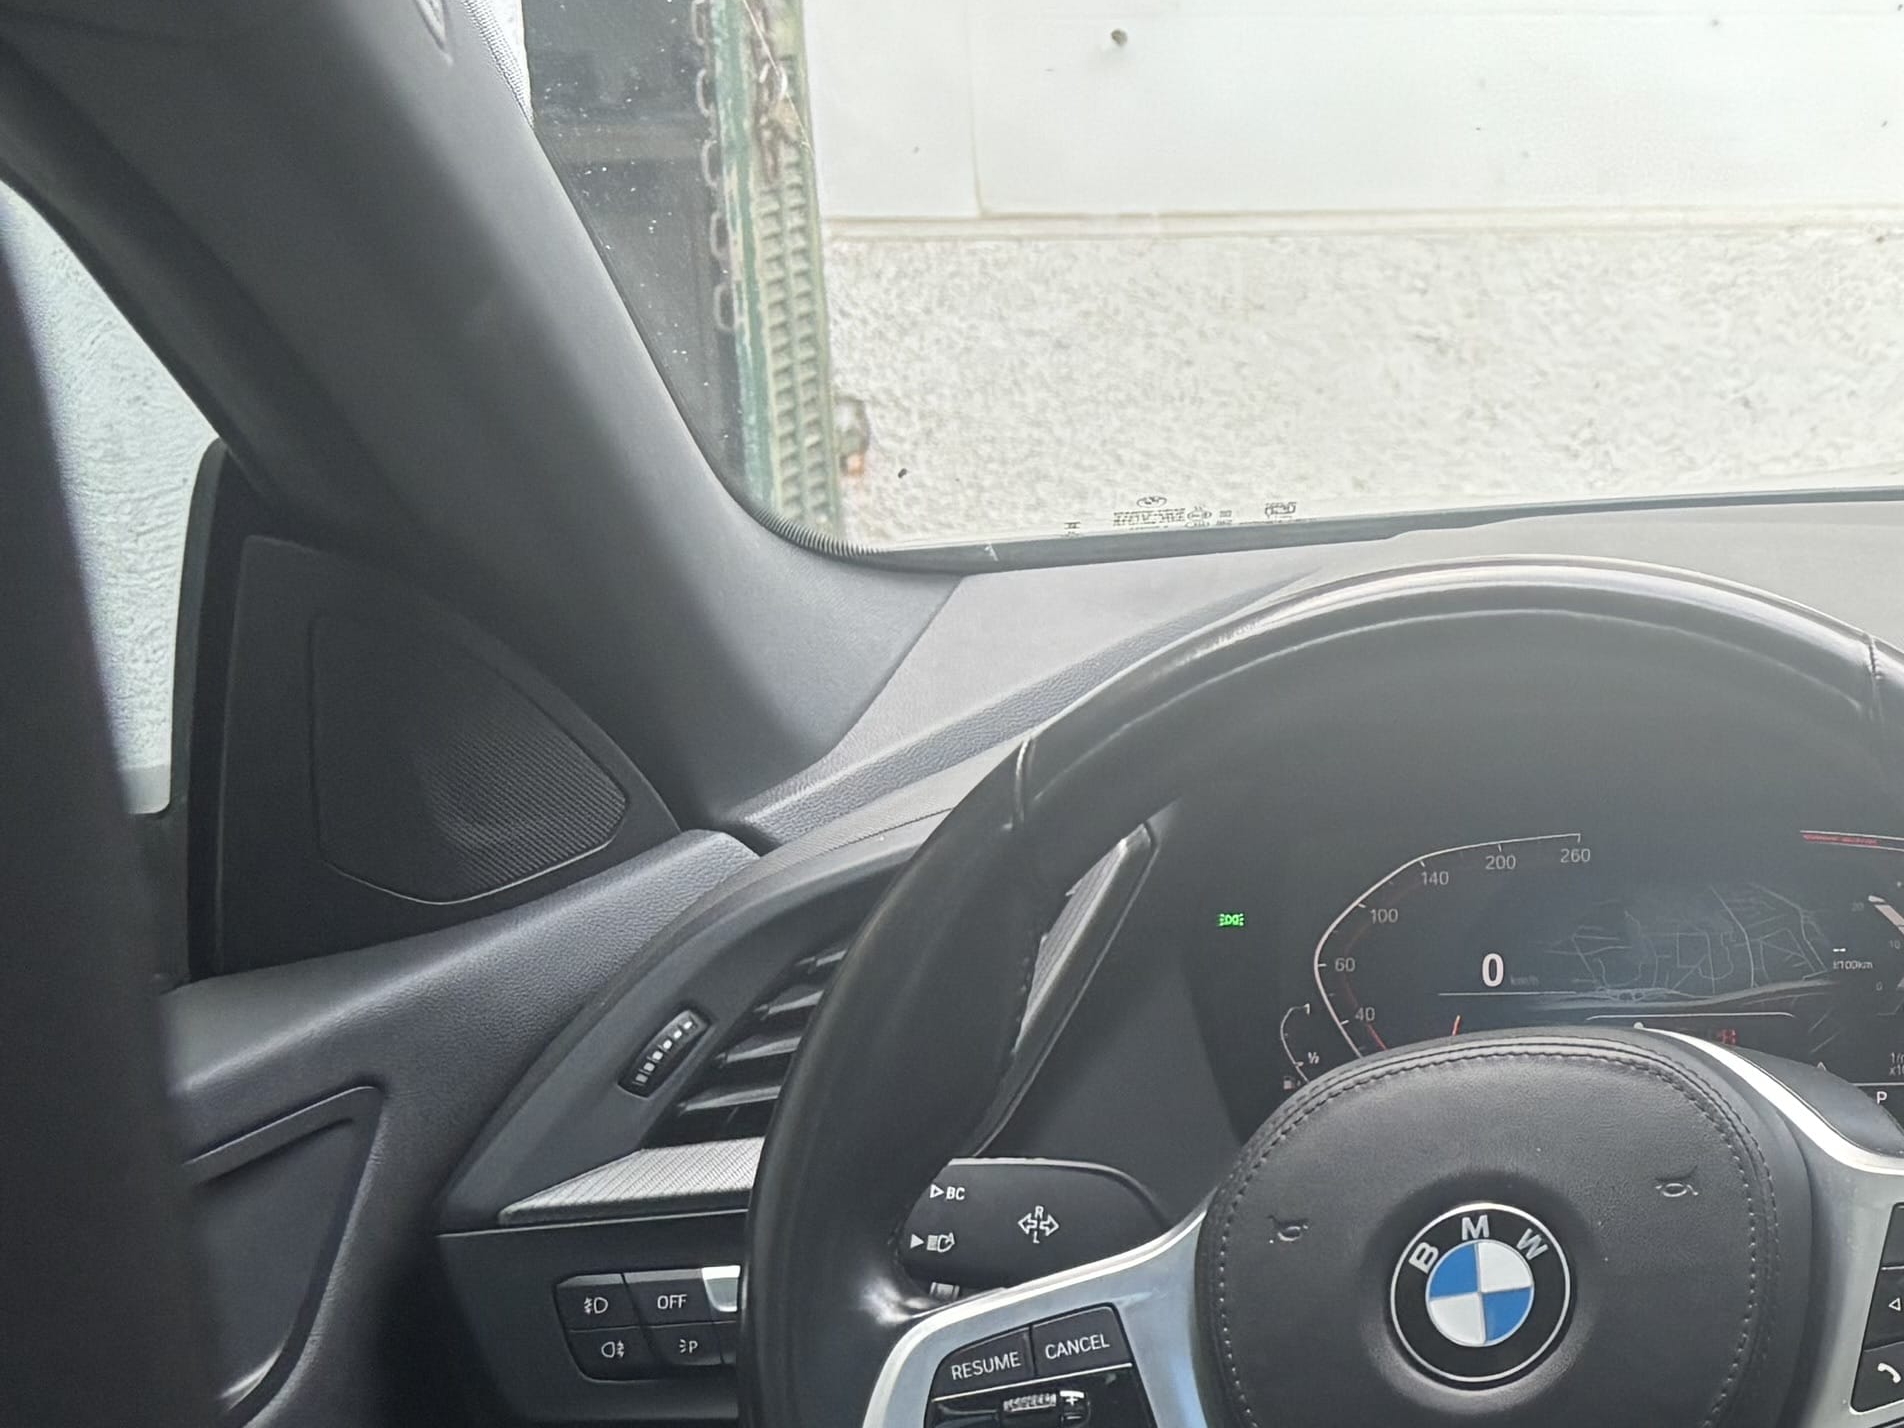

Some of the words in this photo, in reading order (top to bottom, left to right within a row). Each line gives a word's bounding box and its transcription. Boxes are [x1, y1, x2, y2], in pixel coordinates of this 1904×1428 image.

[1485, 855, 1516, 870] 200
[1560, 848, 1591, 864] 260
[1421, 871, 1449, 886] 140
[1370, 908, 1399, 923] 100
[1334, 958, 1356, 972] 60
[1482, 953, 1505, 987] 0
[1355, 1007, 1376, 1022] 40
[1877, 1091, 1888, 1104] P
[946, 1186, 965, 1201] BC
[1034, 1206, 1044, 1219] R
[1033, 1231, 1041, 1245] L
[1408, 1214, 1549, 1274] BMW
[656, 1294, 688, 1311] OFF
[688, 1339, 699, 1355] P
[1044, 1333, 1110, 1360] CANCEL
[951, 1351, 1022, 1381] RESUME
